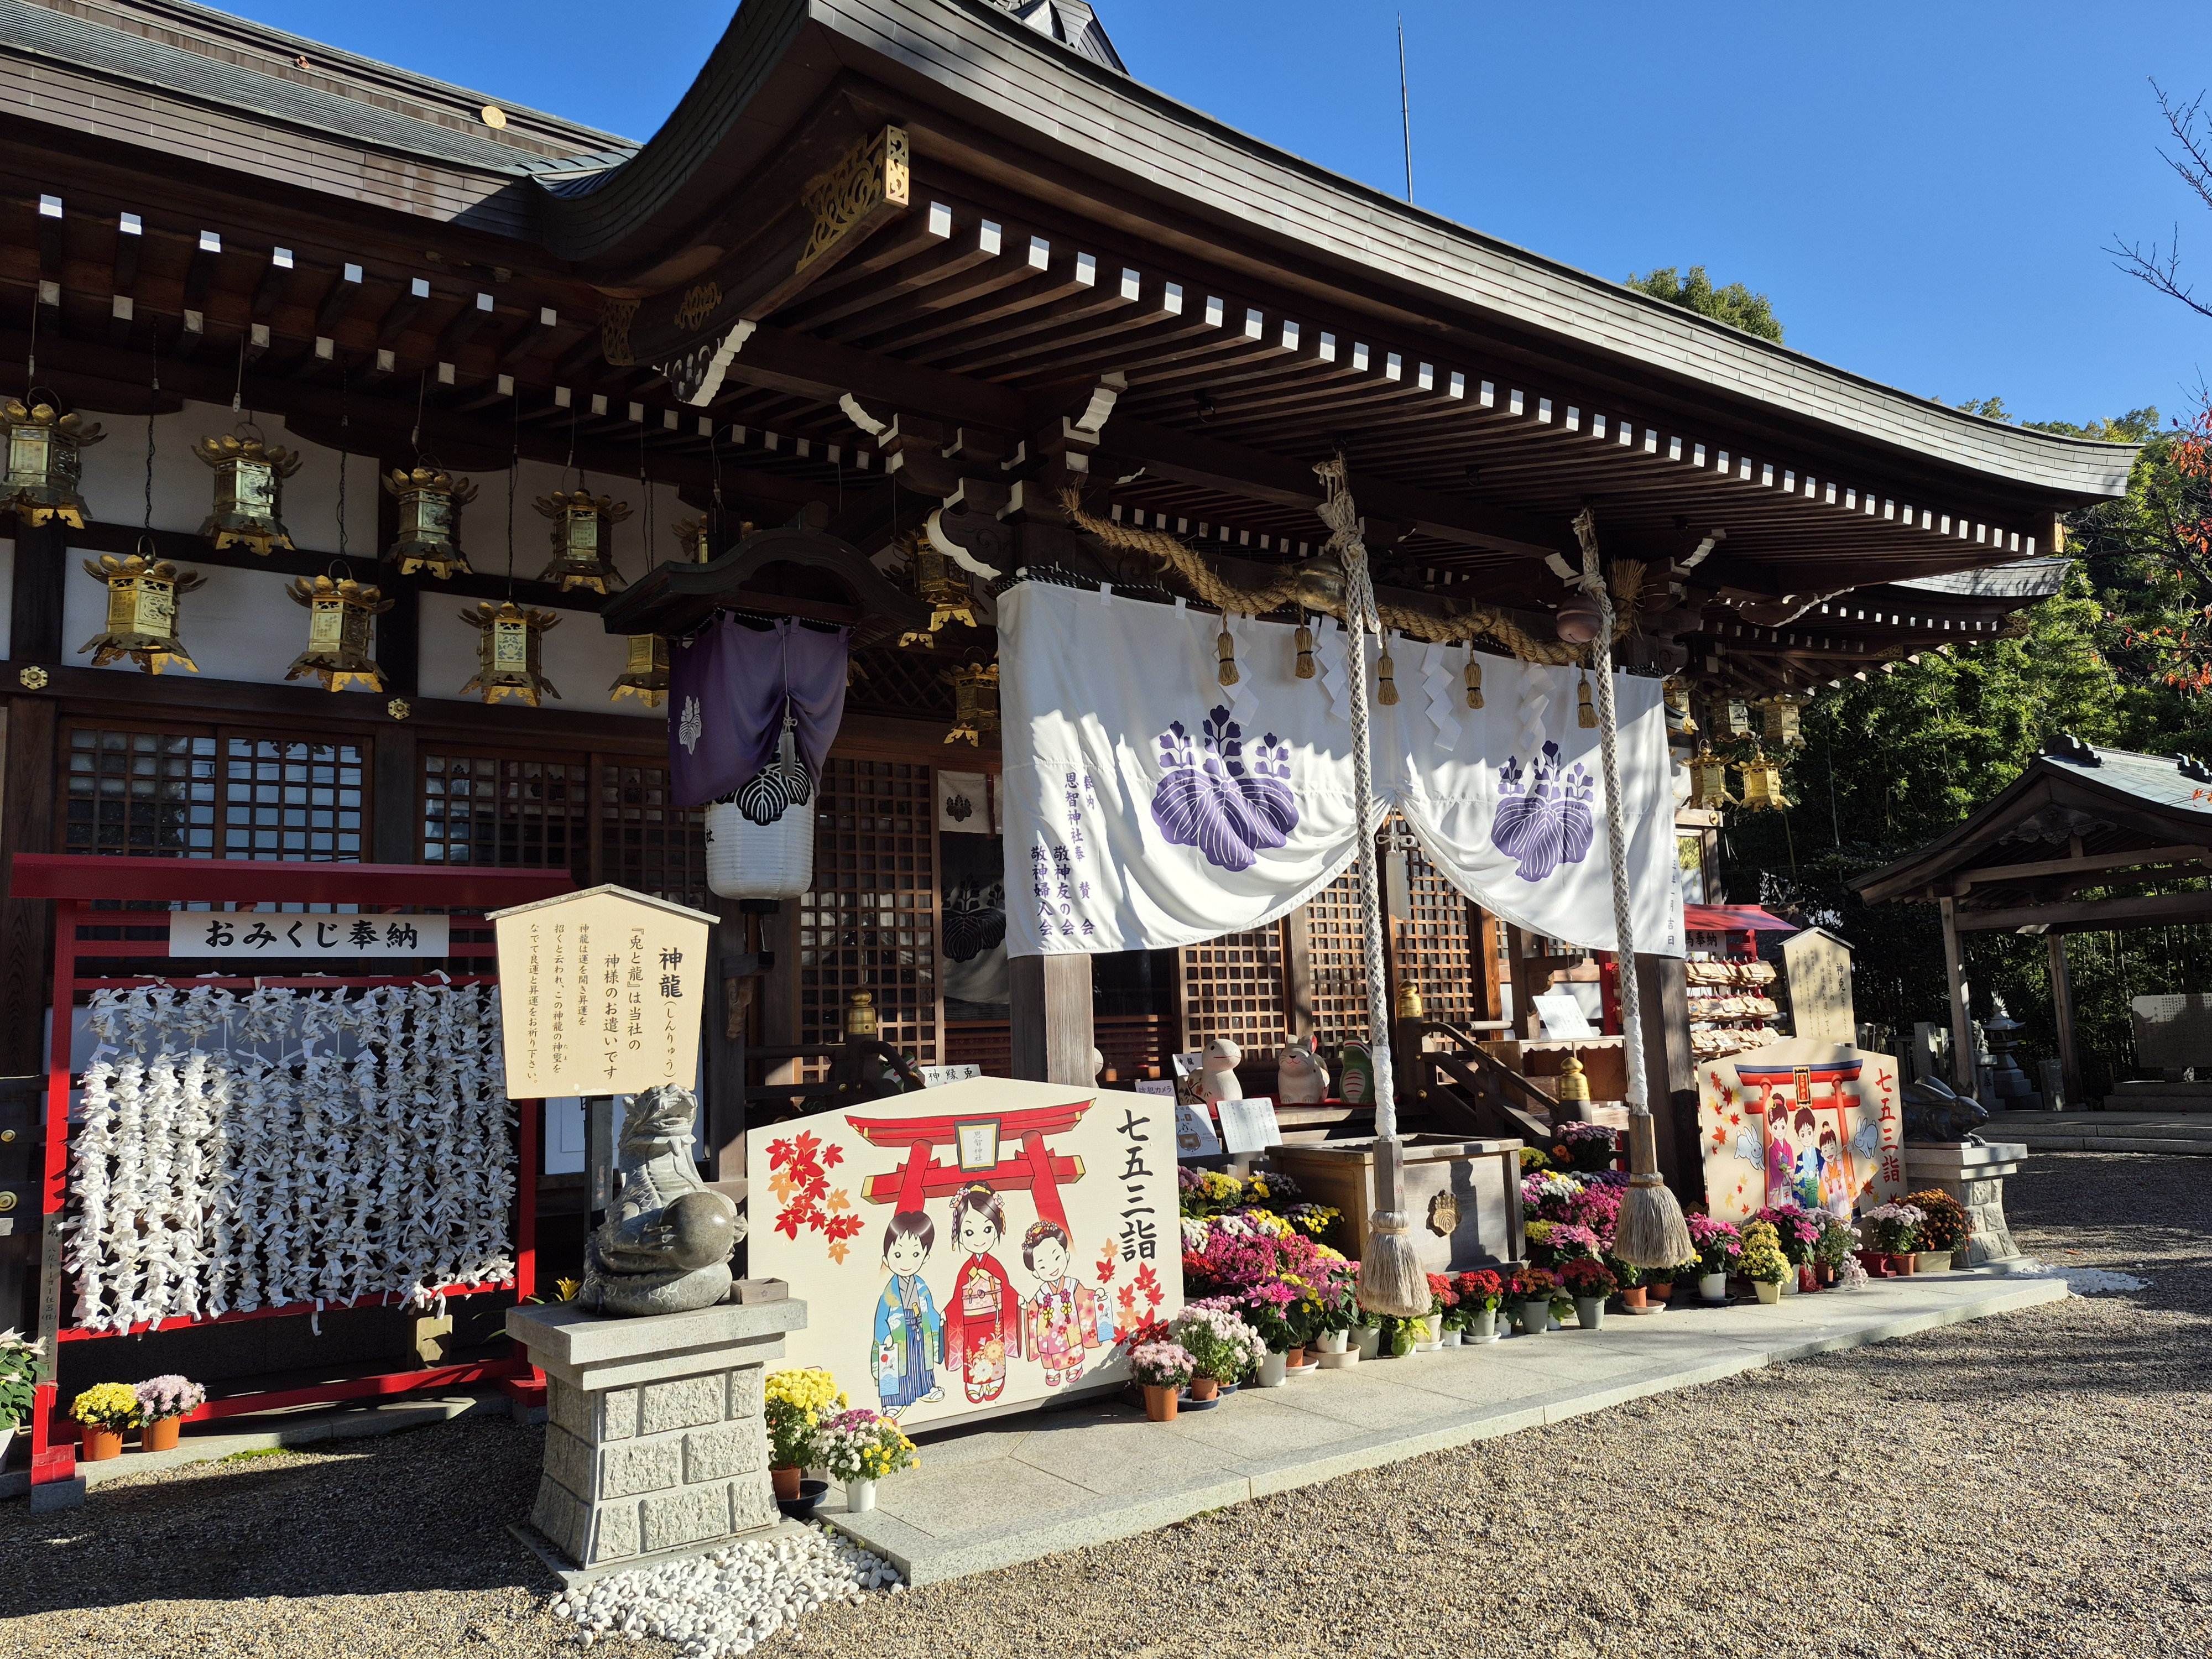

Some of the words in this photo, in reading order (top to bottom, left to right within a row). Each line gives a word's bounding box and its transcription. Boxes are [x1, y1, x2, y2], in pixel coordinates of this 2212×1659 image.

[205, 919, 419, 951] おみくじ奉納
[1030, 845, 1053, 936] 敬神婦人会
[1053, 845, 1076, 936] 敬神友の会
[527, 924, 540, 1084] なでて良運と昇運をお祈り下さい。
[577, 924, 589, 1026] 神龍は運を開き昇運を
[602, 954, 620, 1080] 神様のお遣いです
[627, 927, 644, 1050] 『兎と龍』は当社の
[1139, 1086, 1172, 1094] 防犯カメラ
[1875, 1067, 1900, 1184] 七五三詣
[973, 1131, 983, 1162] 恩智神社
[1116, 1108, 1158, 1262] 七五三詣
[44, 1327, 53, 1371] 令和元年十二
